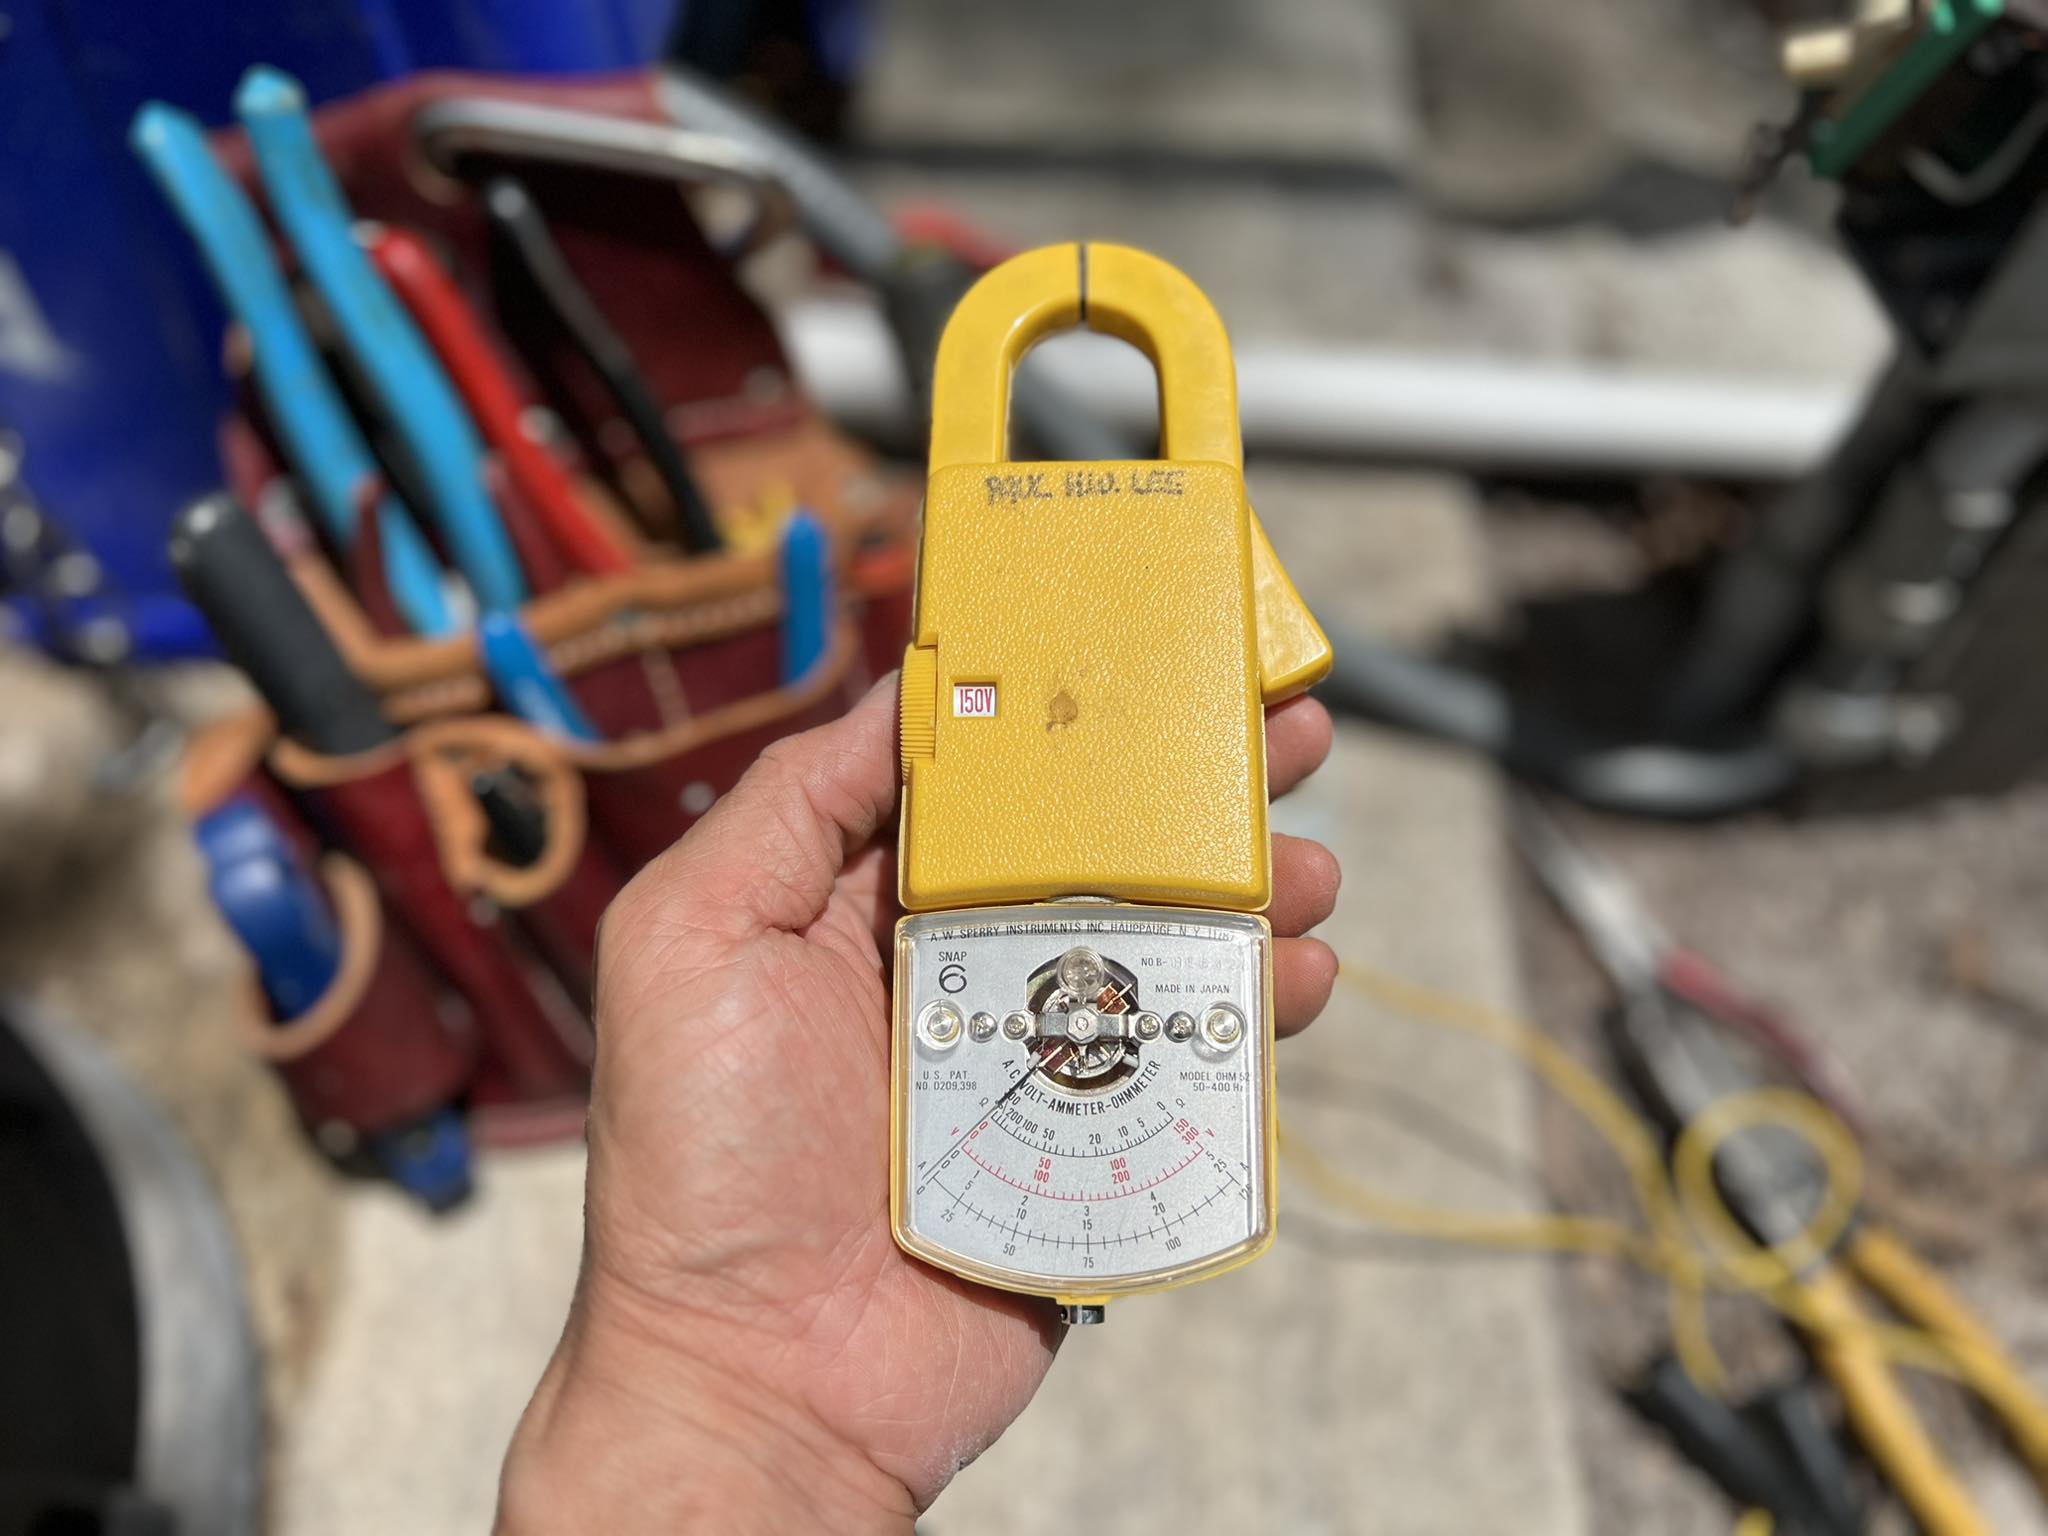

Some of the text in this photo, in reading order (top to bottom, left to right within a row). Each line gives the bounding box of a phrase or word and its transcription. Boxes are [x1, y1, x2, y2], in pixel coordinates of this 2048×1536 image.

[960, 688, 993, 713] 150V
[960, 926, 999, 939] SPERRY
[1006, 922, 1081, 935] INSTRUMENTS
[938, 951, 967, 961] SNAP
[938, 964, 967, 993] 6
[1155, 984, 1230, 994] MADE IN JAPAN
[1179, 1071, 1211, 1081] MODEL
[1216, 1071, 1237, 1081] OHM
[1193, 1082, 1230, 1092] 50-400
[1006, 1108, 1023, 1124] 200
[1023, 1118, 1038, 1133] 100
[1042, 1128, 1055, 1140] 50
[1089, 1133, 1101, 1145] 20
[1118, 1125, 1129, 1137] 10
[1137, 1117, 1145, 1128] 5
[1157, 1101, 1166, 1111] 0
[1173, 1118, 1190, 1135] 150
[1181, 1126, 1199, 1145] 300
[1205, 1151, 1215, 1161] 5
[1039, 1156, 1051, 1170] 50
[1110, 1157, 1126, 1171] 100
[1213, 1158, 1227, 1173] 25
[1033, 1170, 1049, 1183] 100
[1112, 1171, 1130, 1185] 200
[965, 1181, 974, 1191] 5
[1021, 1195, 1028, 1206] 2
[1150, 1191, 1157, 1201] 4
[1016, 1207, 1027, 1220] 10
[1084, 1206, 1090, 1216] 3
[1153, 1202, 1166, 1216] 20
[941, 1209, 955, 1223] 25
[1083, 1219, 1093, 1230] 15
[1003, 1243, 1016, 1256] 50
[1165, 1237, 1182, 1251] 100
[1083, 1257, 1094, 1269] 75
